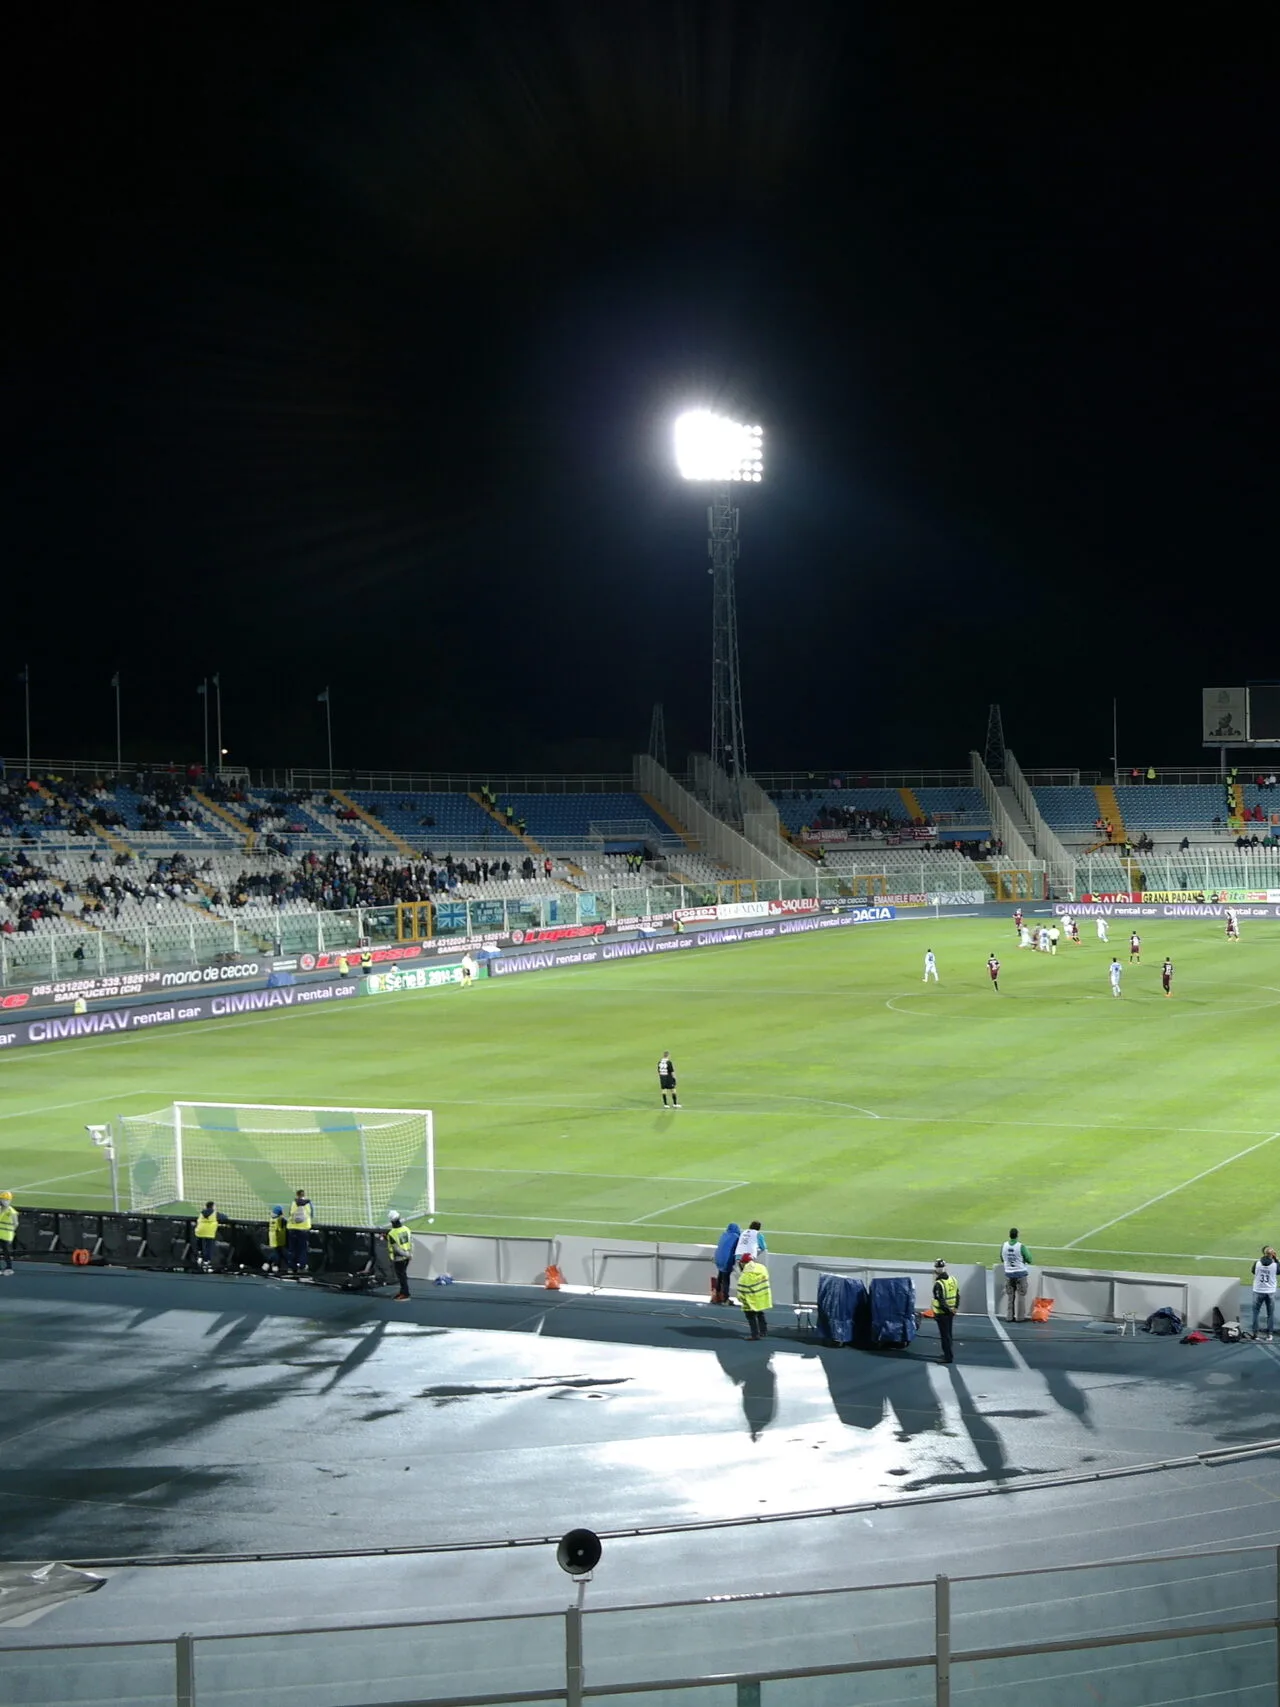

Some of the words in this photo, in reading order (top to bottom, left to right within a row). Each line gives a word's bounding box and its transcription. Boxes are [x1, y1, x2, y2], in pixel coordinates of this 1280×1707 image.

[874, 895, 908, 904] EMANUELE
[1143, 893, 1168, 903] GRANA
[1173, 892, 1203, 903] PADAN
[781, 898, 819, 912] SAQUELLA
[1055, 904, 1112, 915] CIMMAV
[1114, 907, 1140, 915] rental
[1164, 904, 1223, 915] CIMMAV
[853, 908, 891, 921] DACIA
[780, 918, 820, 933] CIMMAV
[820, 917, 840, 927] rental
[841, 917, 852, 925] car
[697, 927, 744, 945] CIMMAV
[744, 928, 763, 937] rental
[603, 940, 655, 958] CIMMAV
[656, 939, 679, 950] rental
[680, 939, 692, 947] car
[495, 953, 555, 973] CIMMAV
[556, 951, 581, 965] rental
[583, 952, 597, 961] car
[204, 965, 218, 980] de
[220, 963, 258, 979] cecco
[119, 983, 142, 996] (CH)
[212, 989, 295, 1015] CIMMAV
[297, 985, 332, 1001] rental
[335, 985, 356, 997] car
[28, 1010, 131, 1041] CIMMAV
[133, 1007, 175, 1026] rental
[178, 1006, 201, 1019] car
[1259, 1274, 1270, 1283] 33
